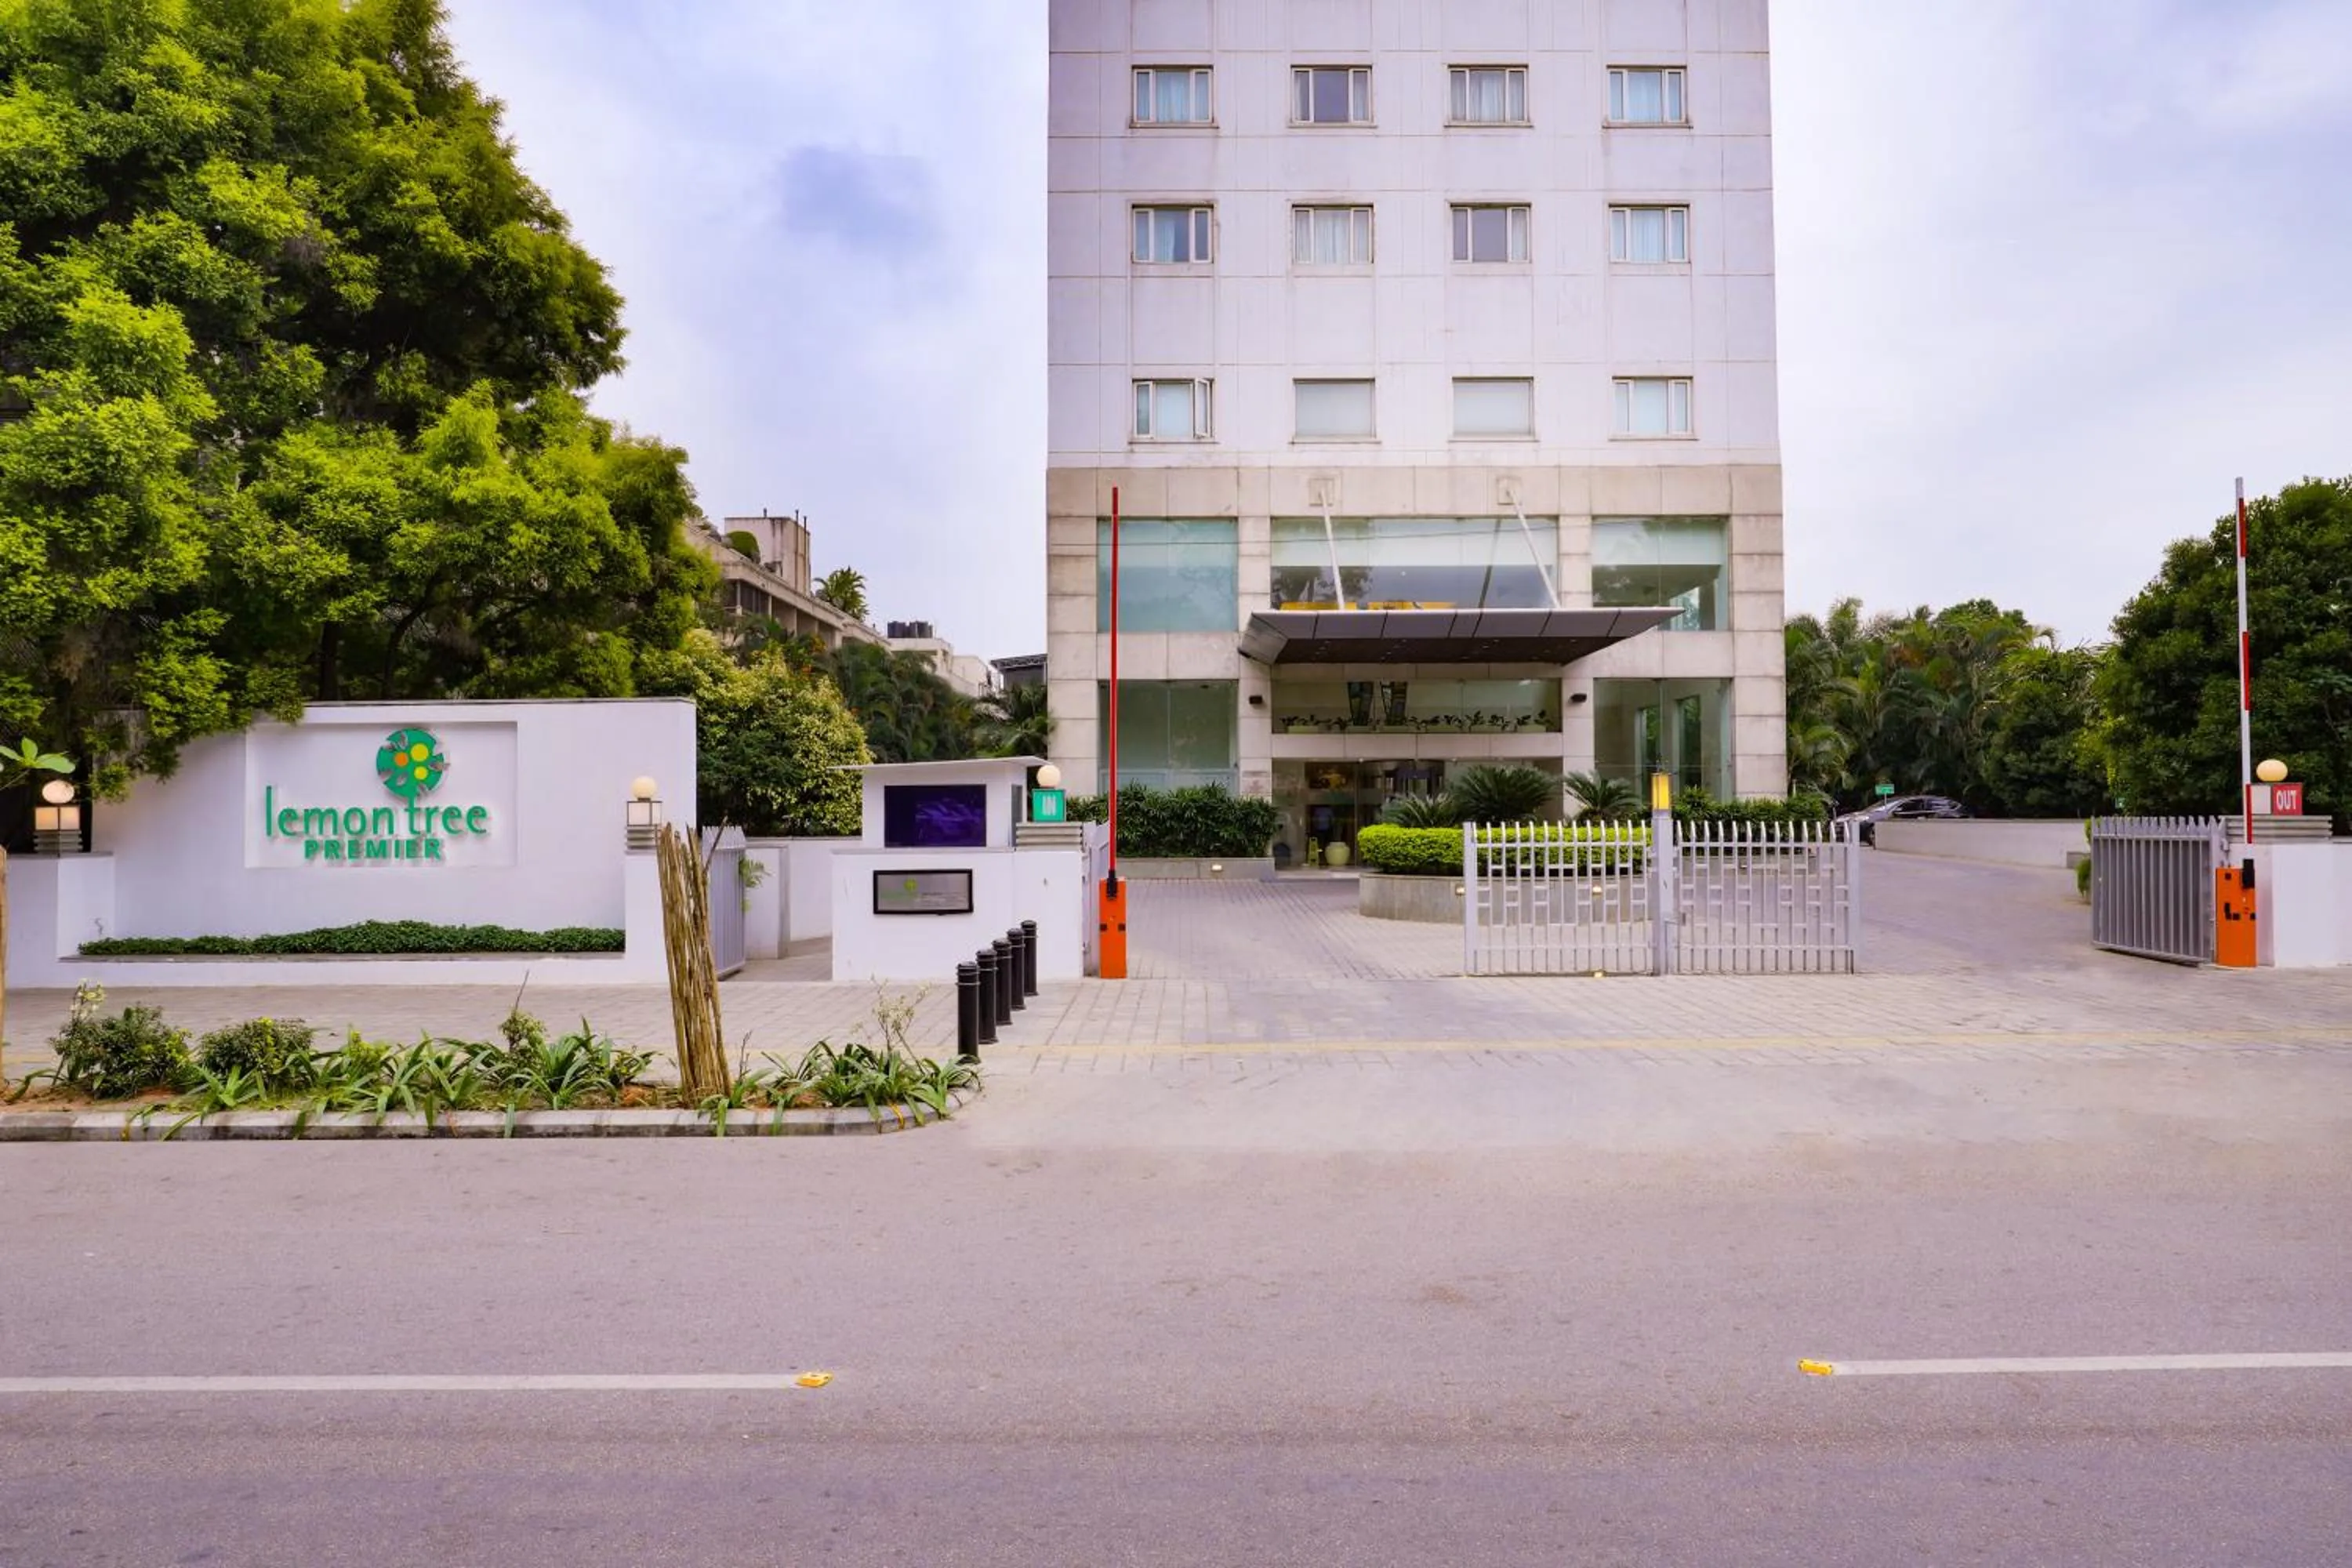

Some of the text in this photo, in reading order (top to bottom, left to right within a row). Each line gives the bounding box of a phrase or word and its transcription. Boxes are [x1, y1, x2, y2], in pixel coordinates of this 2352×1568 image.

[2276, 789, 2296, 810] OUT
[266, 785, 488, 837] lemon tree
[303, 839, 442, 860] PREMIER
